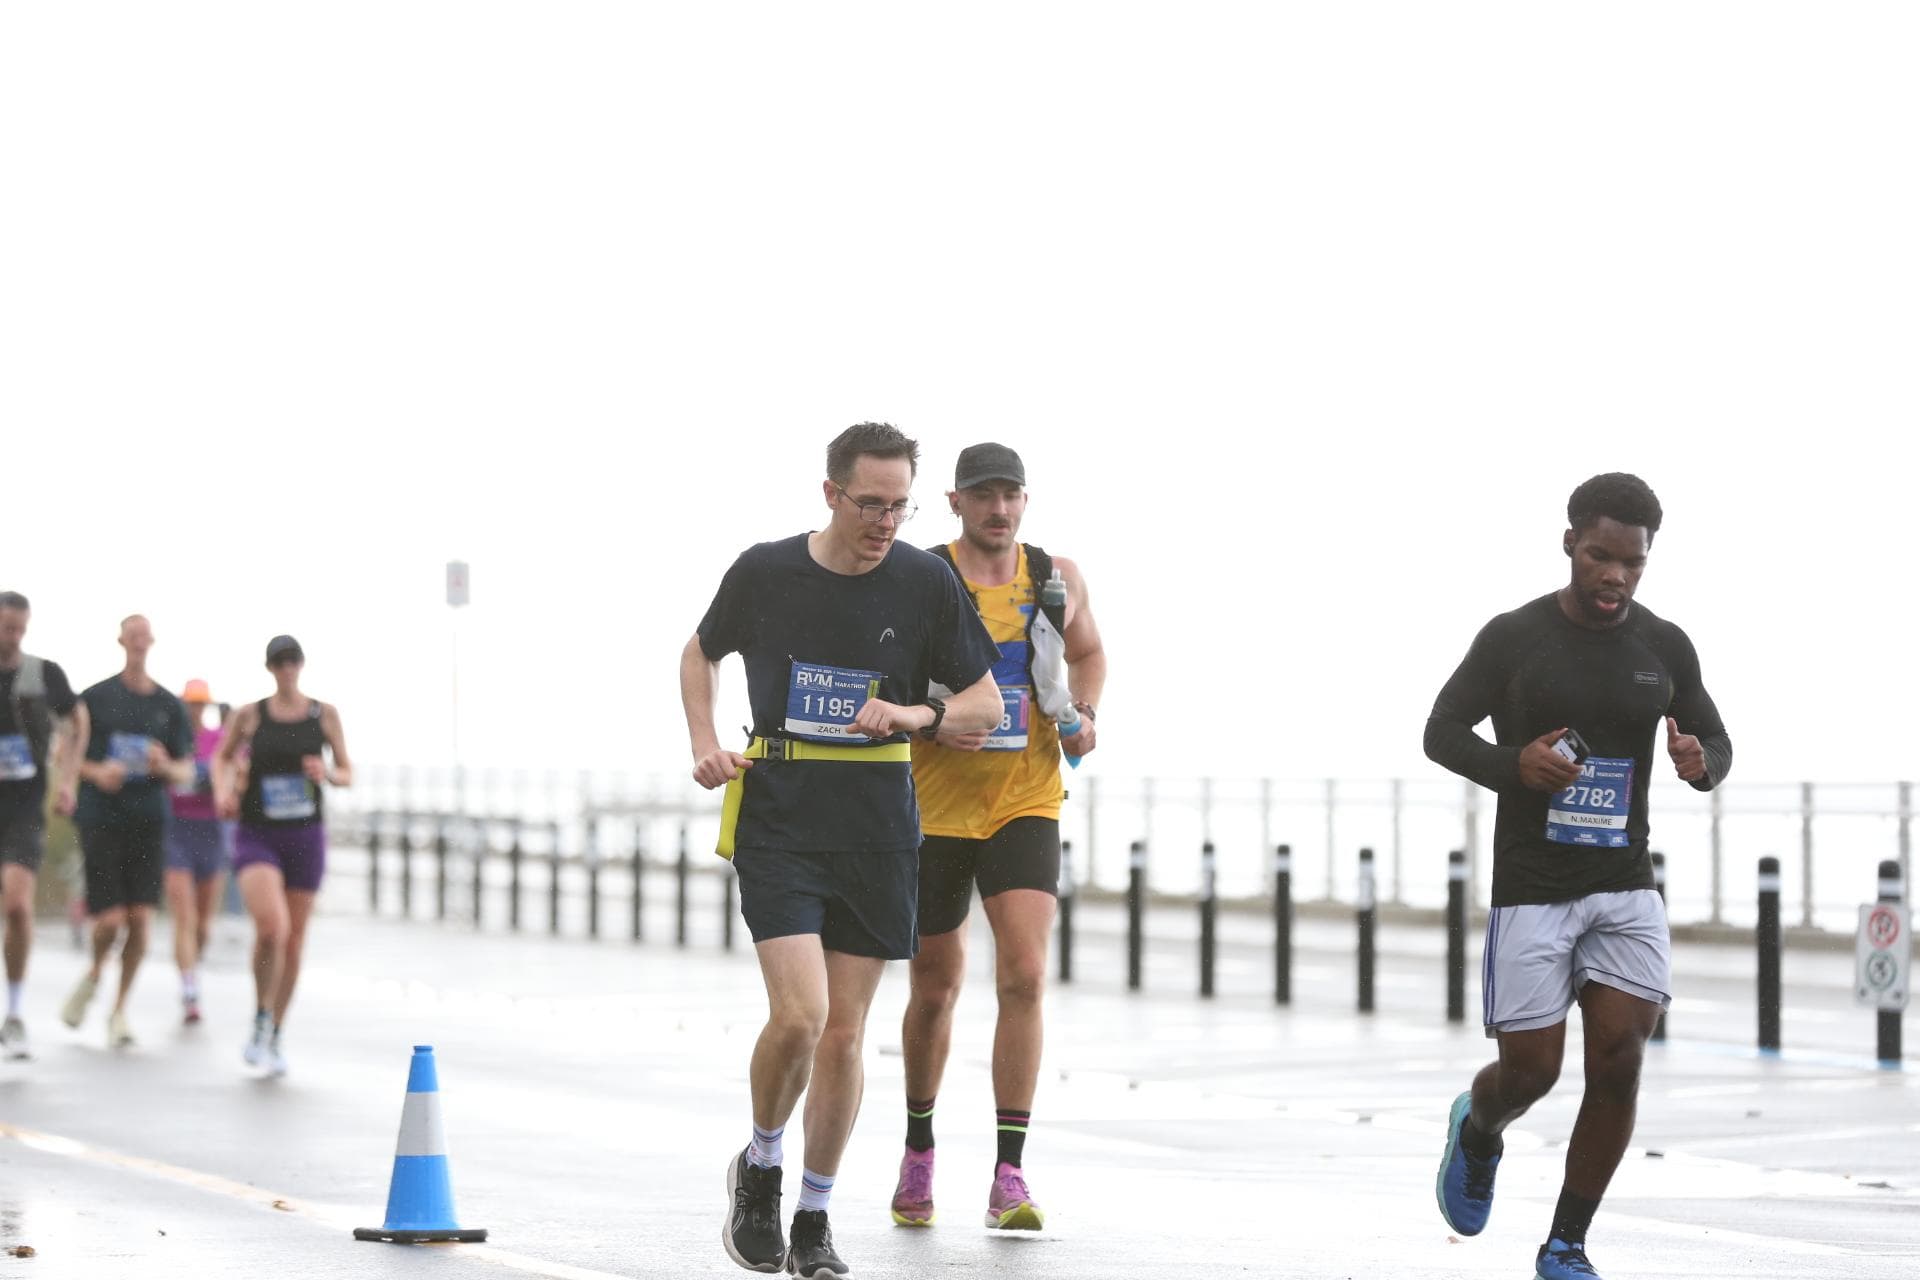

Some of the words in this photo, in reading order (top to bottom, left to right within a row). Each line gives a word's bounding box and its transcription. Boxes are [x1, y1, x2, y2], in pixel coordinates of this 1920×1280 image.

[797, 671, 833, 688] RVM
[803, 694, 856, 718] 1195
[818, 726, 840, 734] ZACH
[1562, 786, 1616, 808] 2782
[1571, 816, 1612, 825] N.MAXIME
